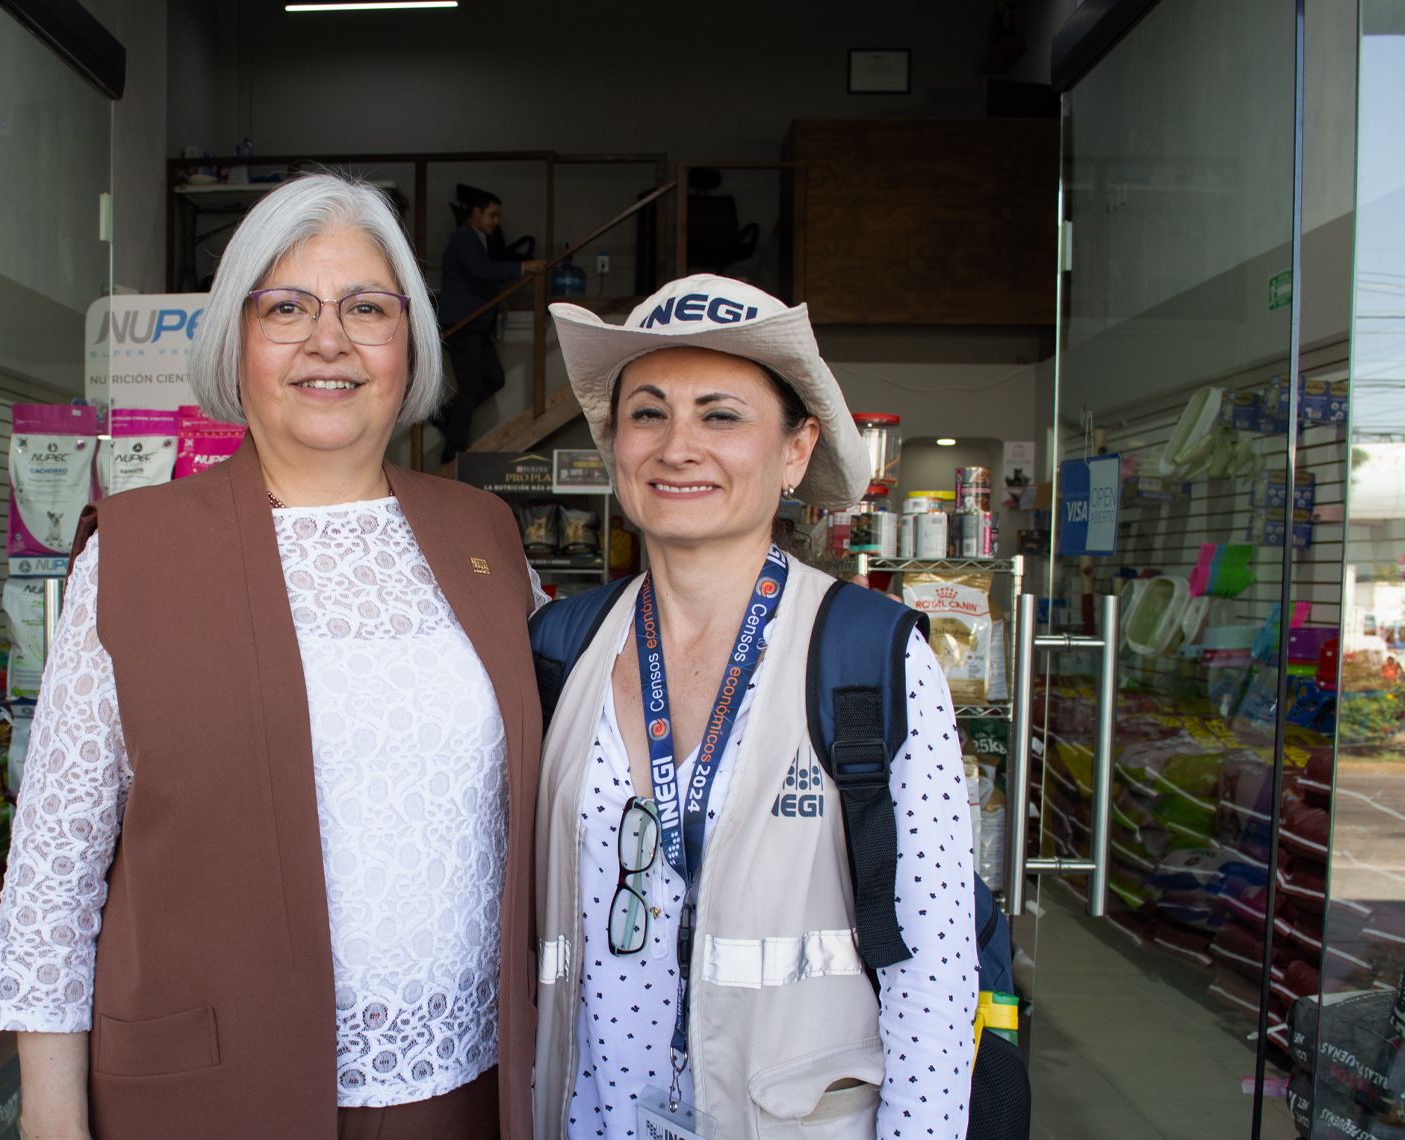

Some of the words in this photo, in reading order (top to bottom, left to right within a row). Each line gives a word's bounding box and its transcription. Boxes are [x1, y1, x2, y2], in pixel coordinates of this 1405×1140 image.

[31, 452, 68, 462] NUPEC
[114, 451, 153, 462] NUPEC
[29, 467, 69, 475] CACHORRO
[505, 472, 530, 482] PRO
[494, 483, 530, 491] NUTRICIÓN
[1091, 486, 1117, 508] OPEN
[1066, 500, 1088, 522] VISA
[1090, 510, 1116, 524] ABIERTO
[915, 599, 948, 610] ROYAL
[948, 600, 978, 613] CANIN
[734, 603, 767, 662] Censos
[648, 652, 665, 712] Censos
[700, 666, 741, 763] económicos
[652, 755, 679, 830] INEGI
[687, 763, 711, 813] 2024
